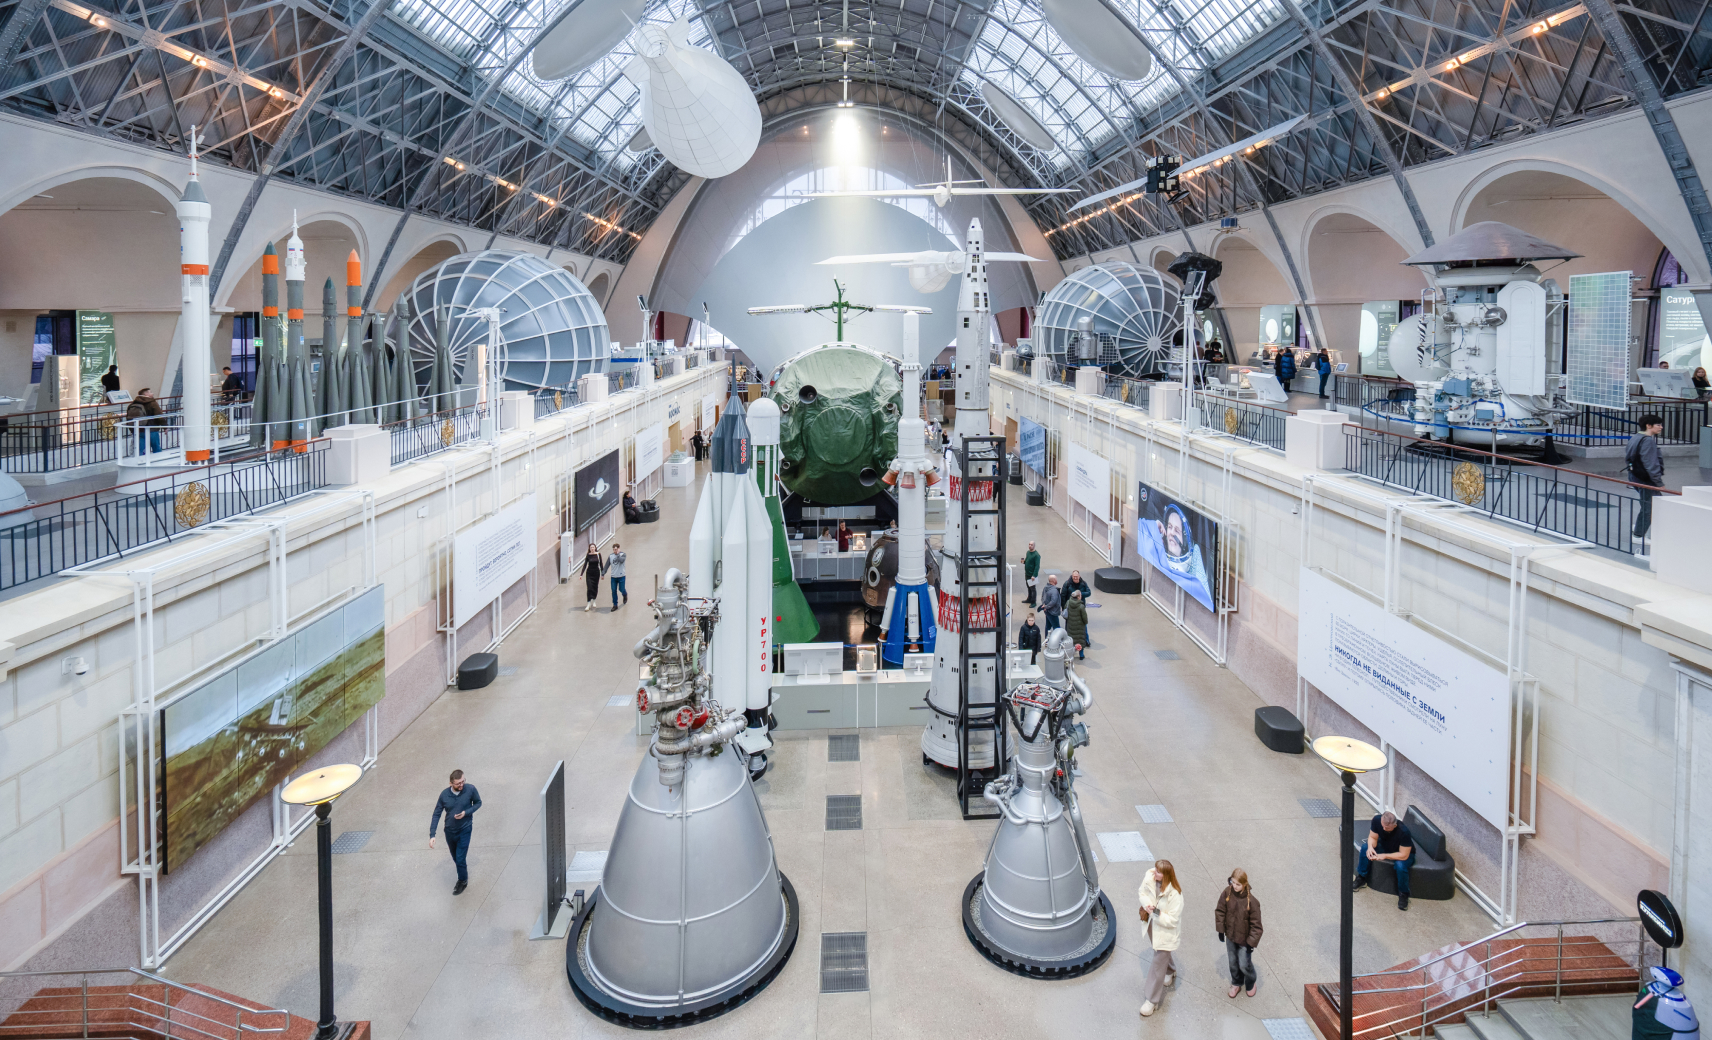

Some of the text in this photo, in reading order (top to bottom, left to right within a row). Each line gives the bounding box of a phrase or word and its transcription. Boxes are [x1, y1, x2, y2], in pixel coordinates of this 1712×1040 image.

[1666, 296, 1695, 305] Сатур
[1335, 644, 1445, 724] НИКОГДА НЕ ВИДАННЫЕ С ЗЕМЛИ
